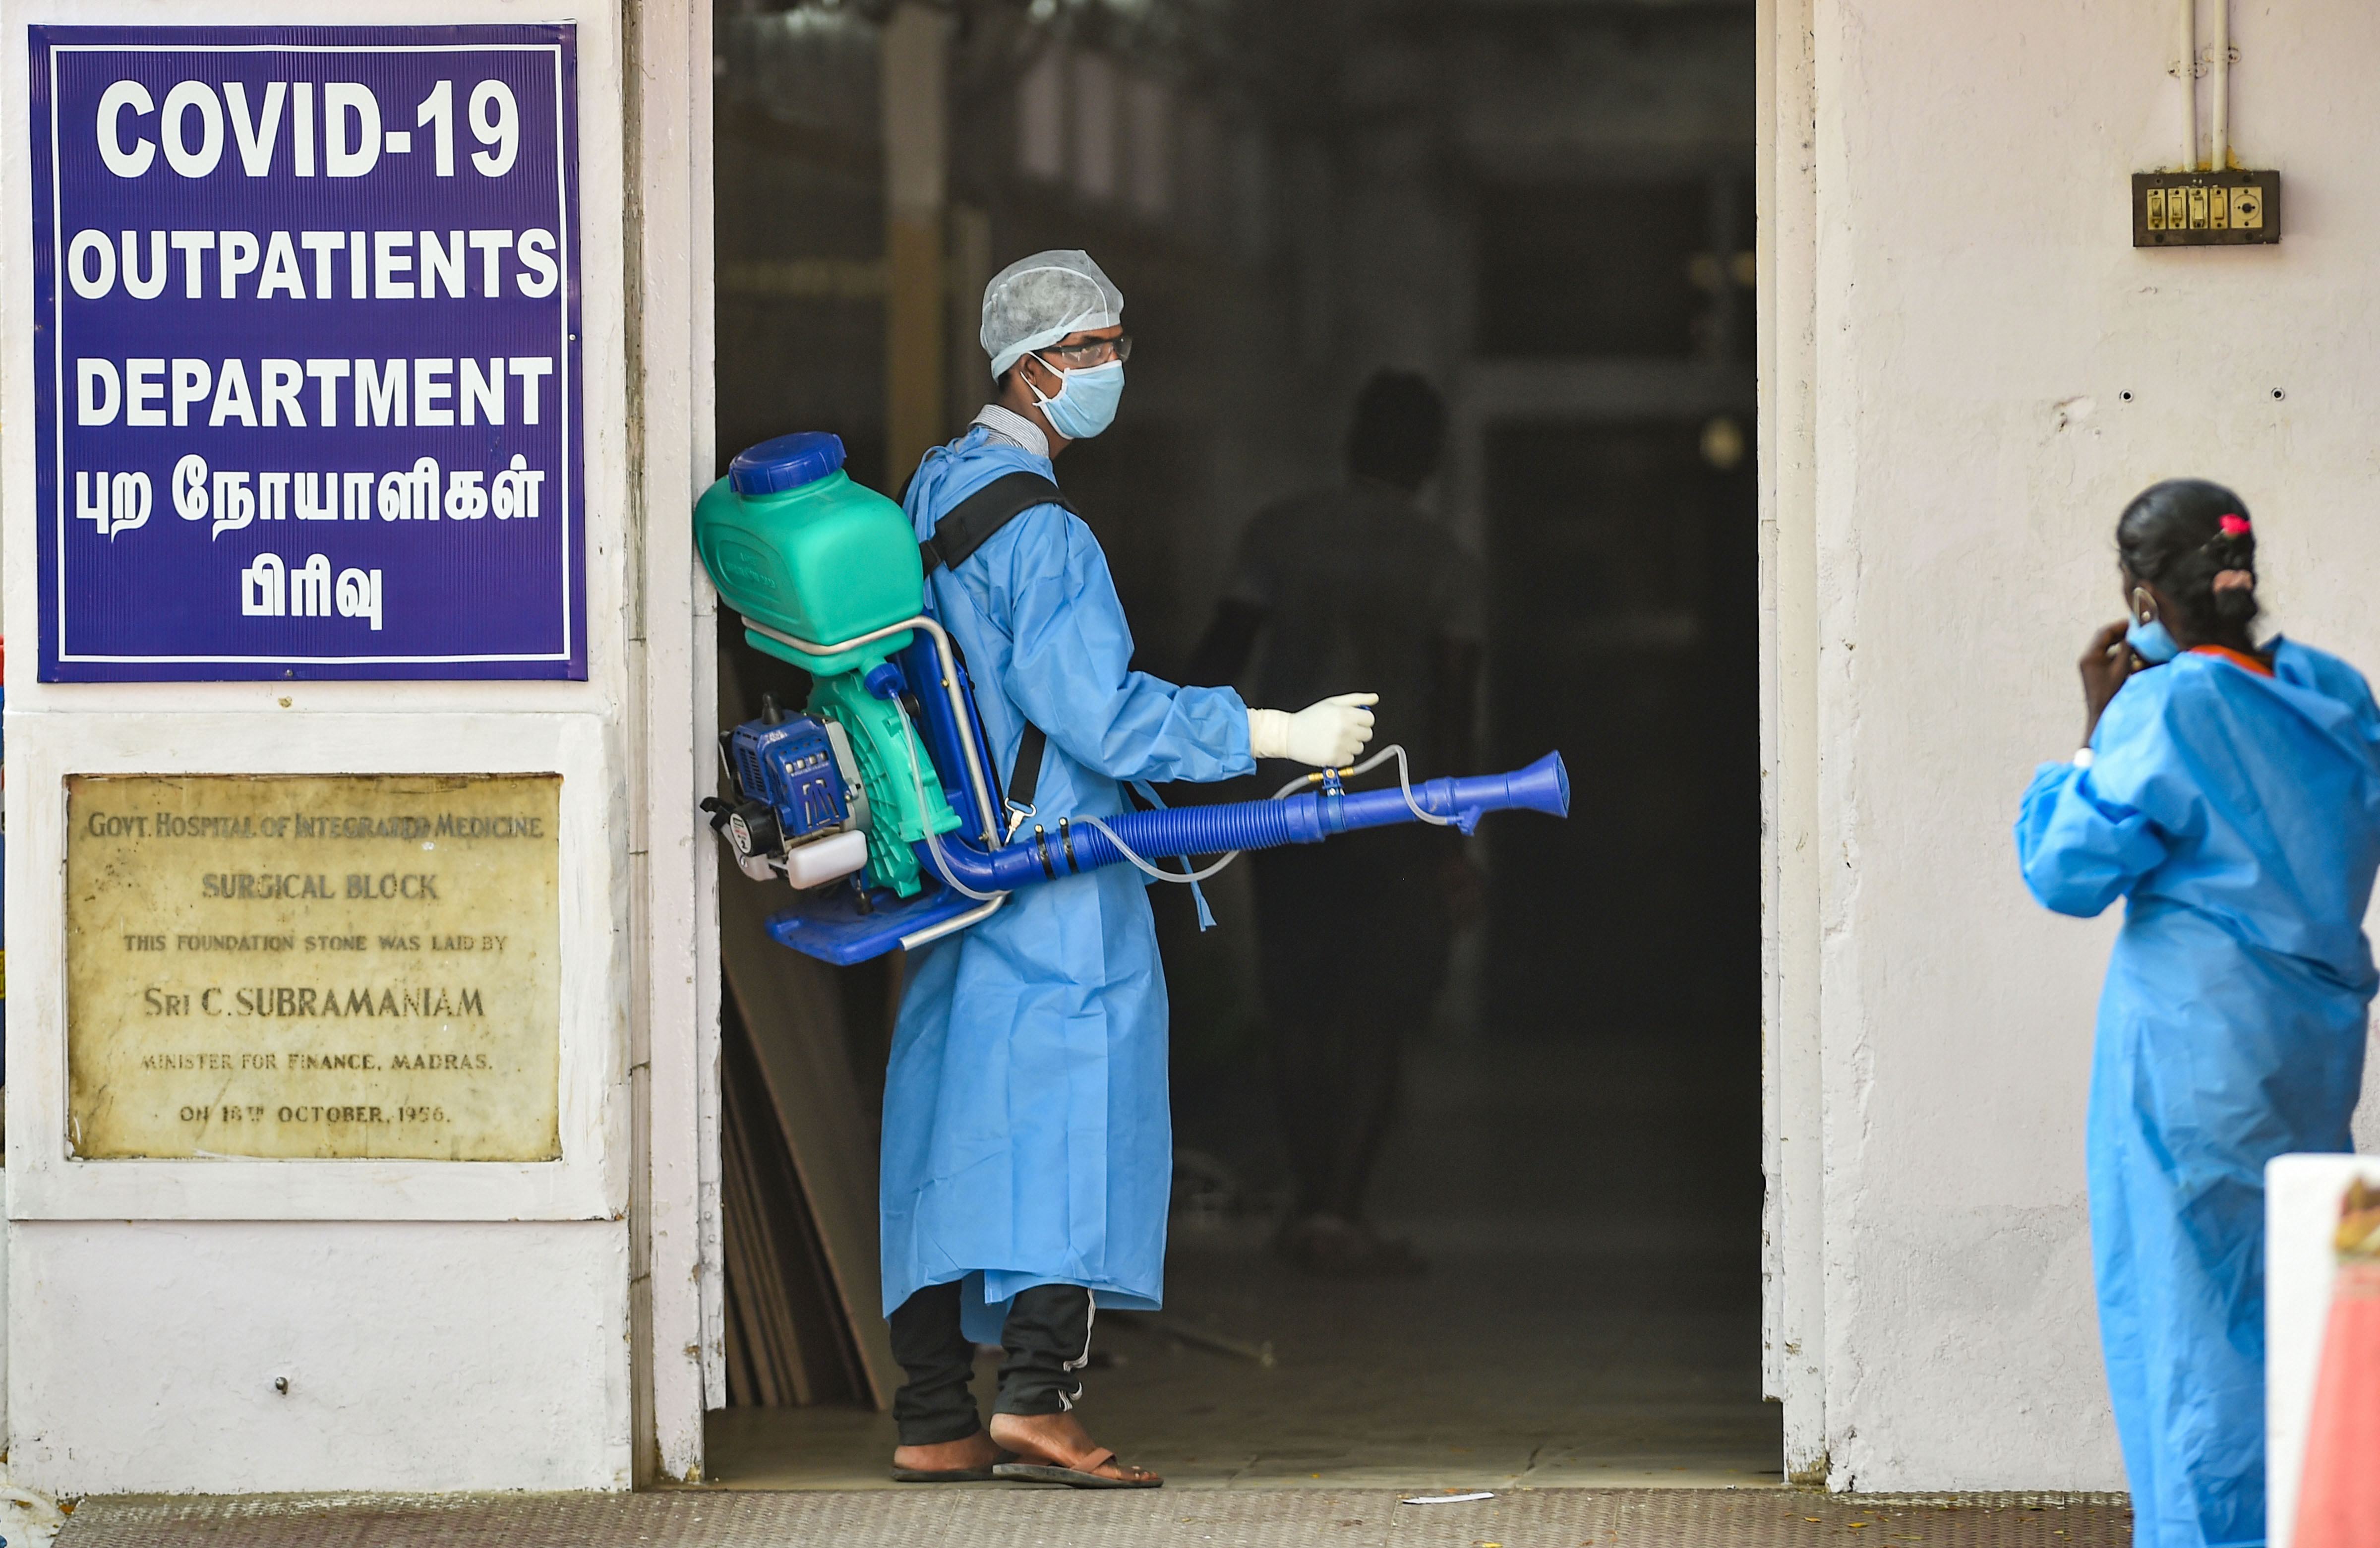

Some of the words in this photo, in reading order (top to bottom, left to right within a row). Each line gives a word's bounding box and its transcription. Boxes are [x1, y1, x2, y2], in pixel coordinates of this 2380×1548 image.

[97, 79, 519, 178] COVID-19
[68, 228, 559, 299] OUTPATIENTS
[77, 357, 553, 427] DEPARTMENT
[76, 472, 153, 543] புற
[172, 454, 545, 541] நோயாளிகள்
[241, 553, 383, 631] பிரிவு
[261, 816, 291, 838] OF
[435, 813, 544, 838] MEDICINE
[202, 873, 334, 899] SURGICAL
[346, 873, 440, 899] BLOCK
[124, 935, 166, 951] THIS
[177, 935, 294, 951] FOUNDATION
[305, 936, 367, 951] STONE
[379, 935, 420, 951] WAS
[431, 935, 474, 951] LAID
[481, 935, 508, 951] BY
[142, 1054, 233, 1070] MINISTER
[242, 1054, 277, 1070] FOR
[180, 1106, 209, 1122] ON
